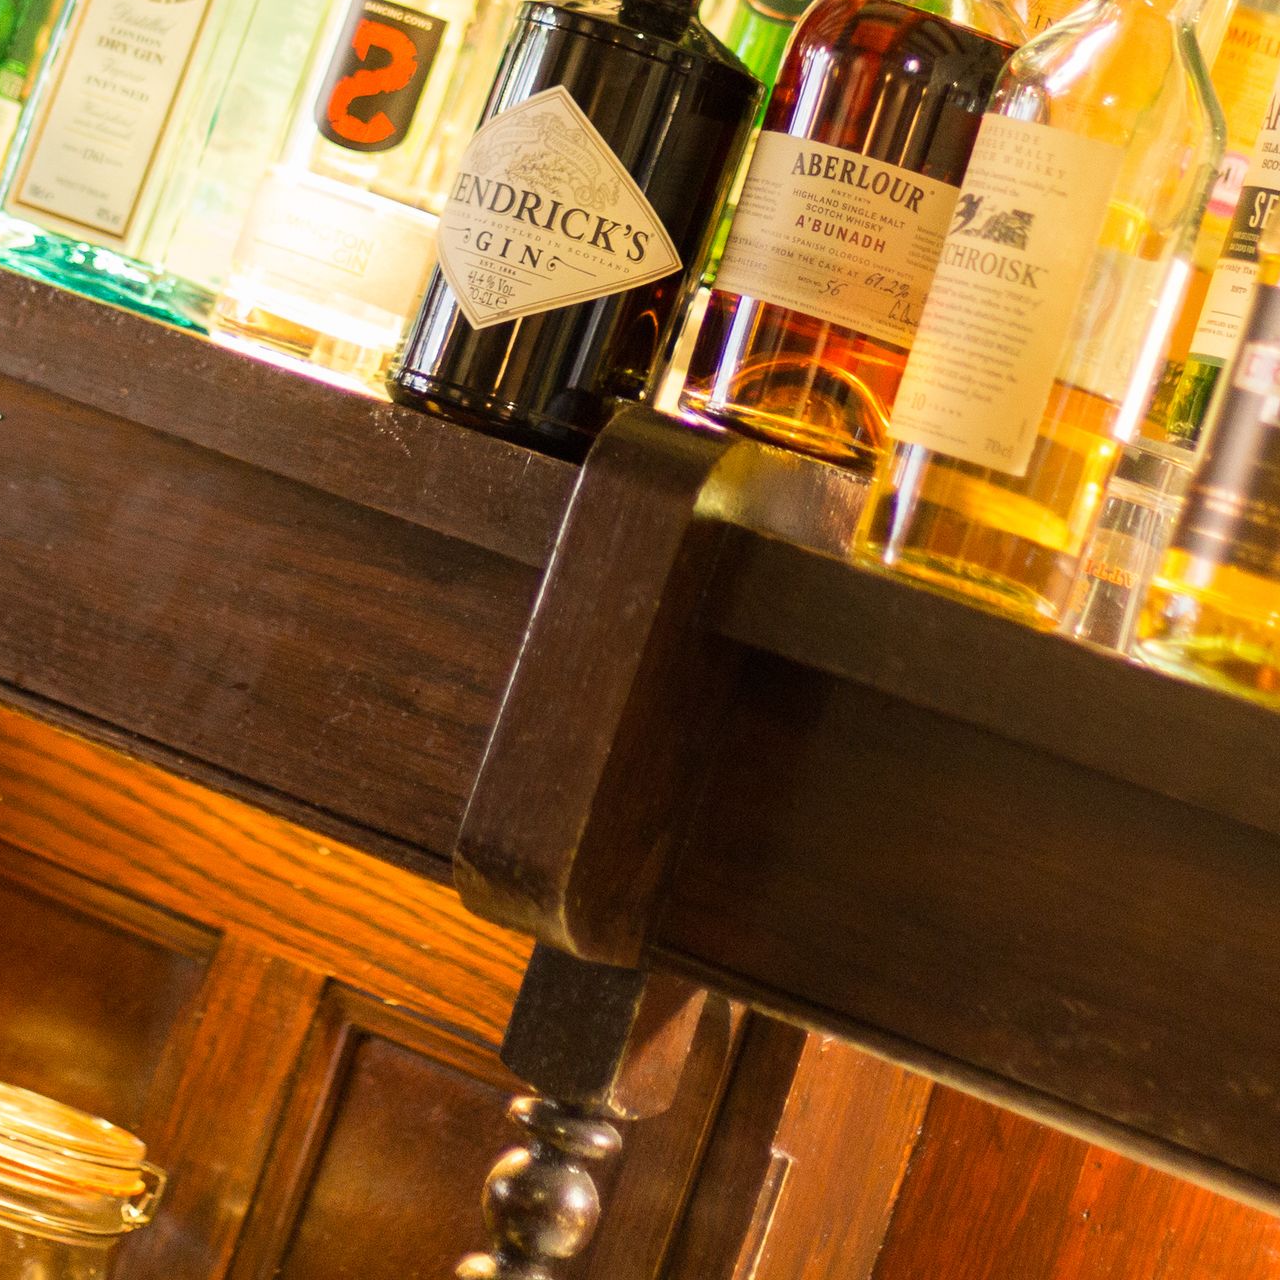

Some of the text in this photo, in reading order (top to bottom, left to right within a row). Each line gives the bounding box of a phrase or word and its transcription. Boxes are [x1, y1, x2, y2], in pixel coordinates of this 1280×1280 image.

[363, 1, 433, 32] DANCING COWS
[96, 35, 134, 57] DRY
[791, 151, 926, 214] ABERLOUR
[451, 172, 649, 262] ENDRICK'S
[793, 187, 840, 209] HIGHLAND
[841, 201, 879, 221] SINGLE
[880, 213, 906, 230] MALT
[805, 203, 884, 233] SCOTCH WHISKY
[476, 231, 544, 269] GIN
[795, 214, 887, 254] A'BUNADH
[567, 247, 630, 274] SCOTLAND
[771, 245, 795, 259] FROM
[798, 253, 815, 266] THE
[818, 260, 843, 275] CASK
[847, 269, 859, 279] AT
[792, 236, 826, 252] SPANISH
[828, 248, 871, 267] OLOROSO
[818, 279, 848, 297] 56
